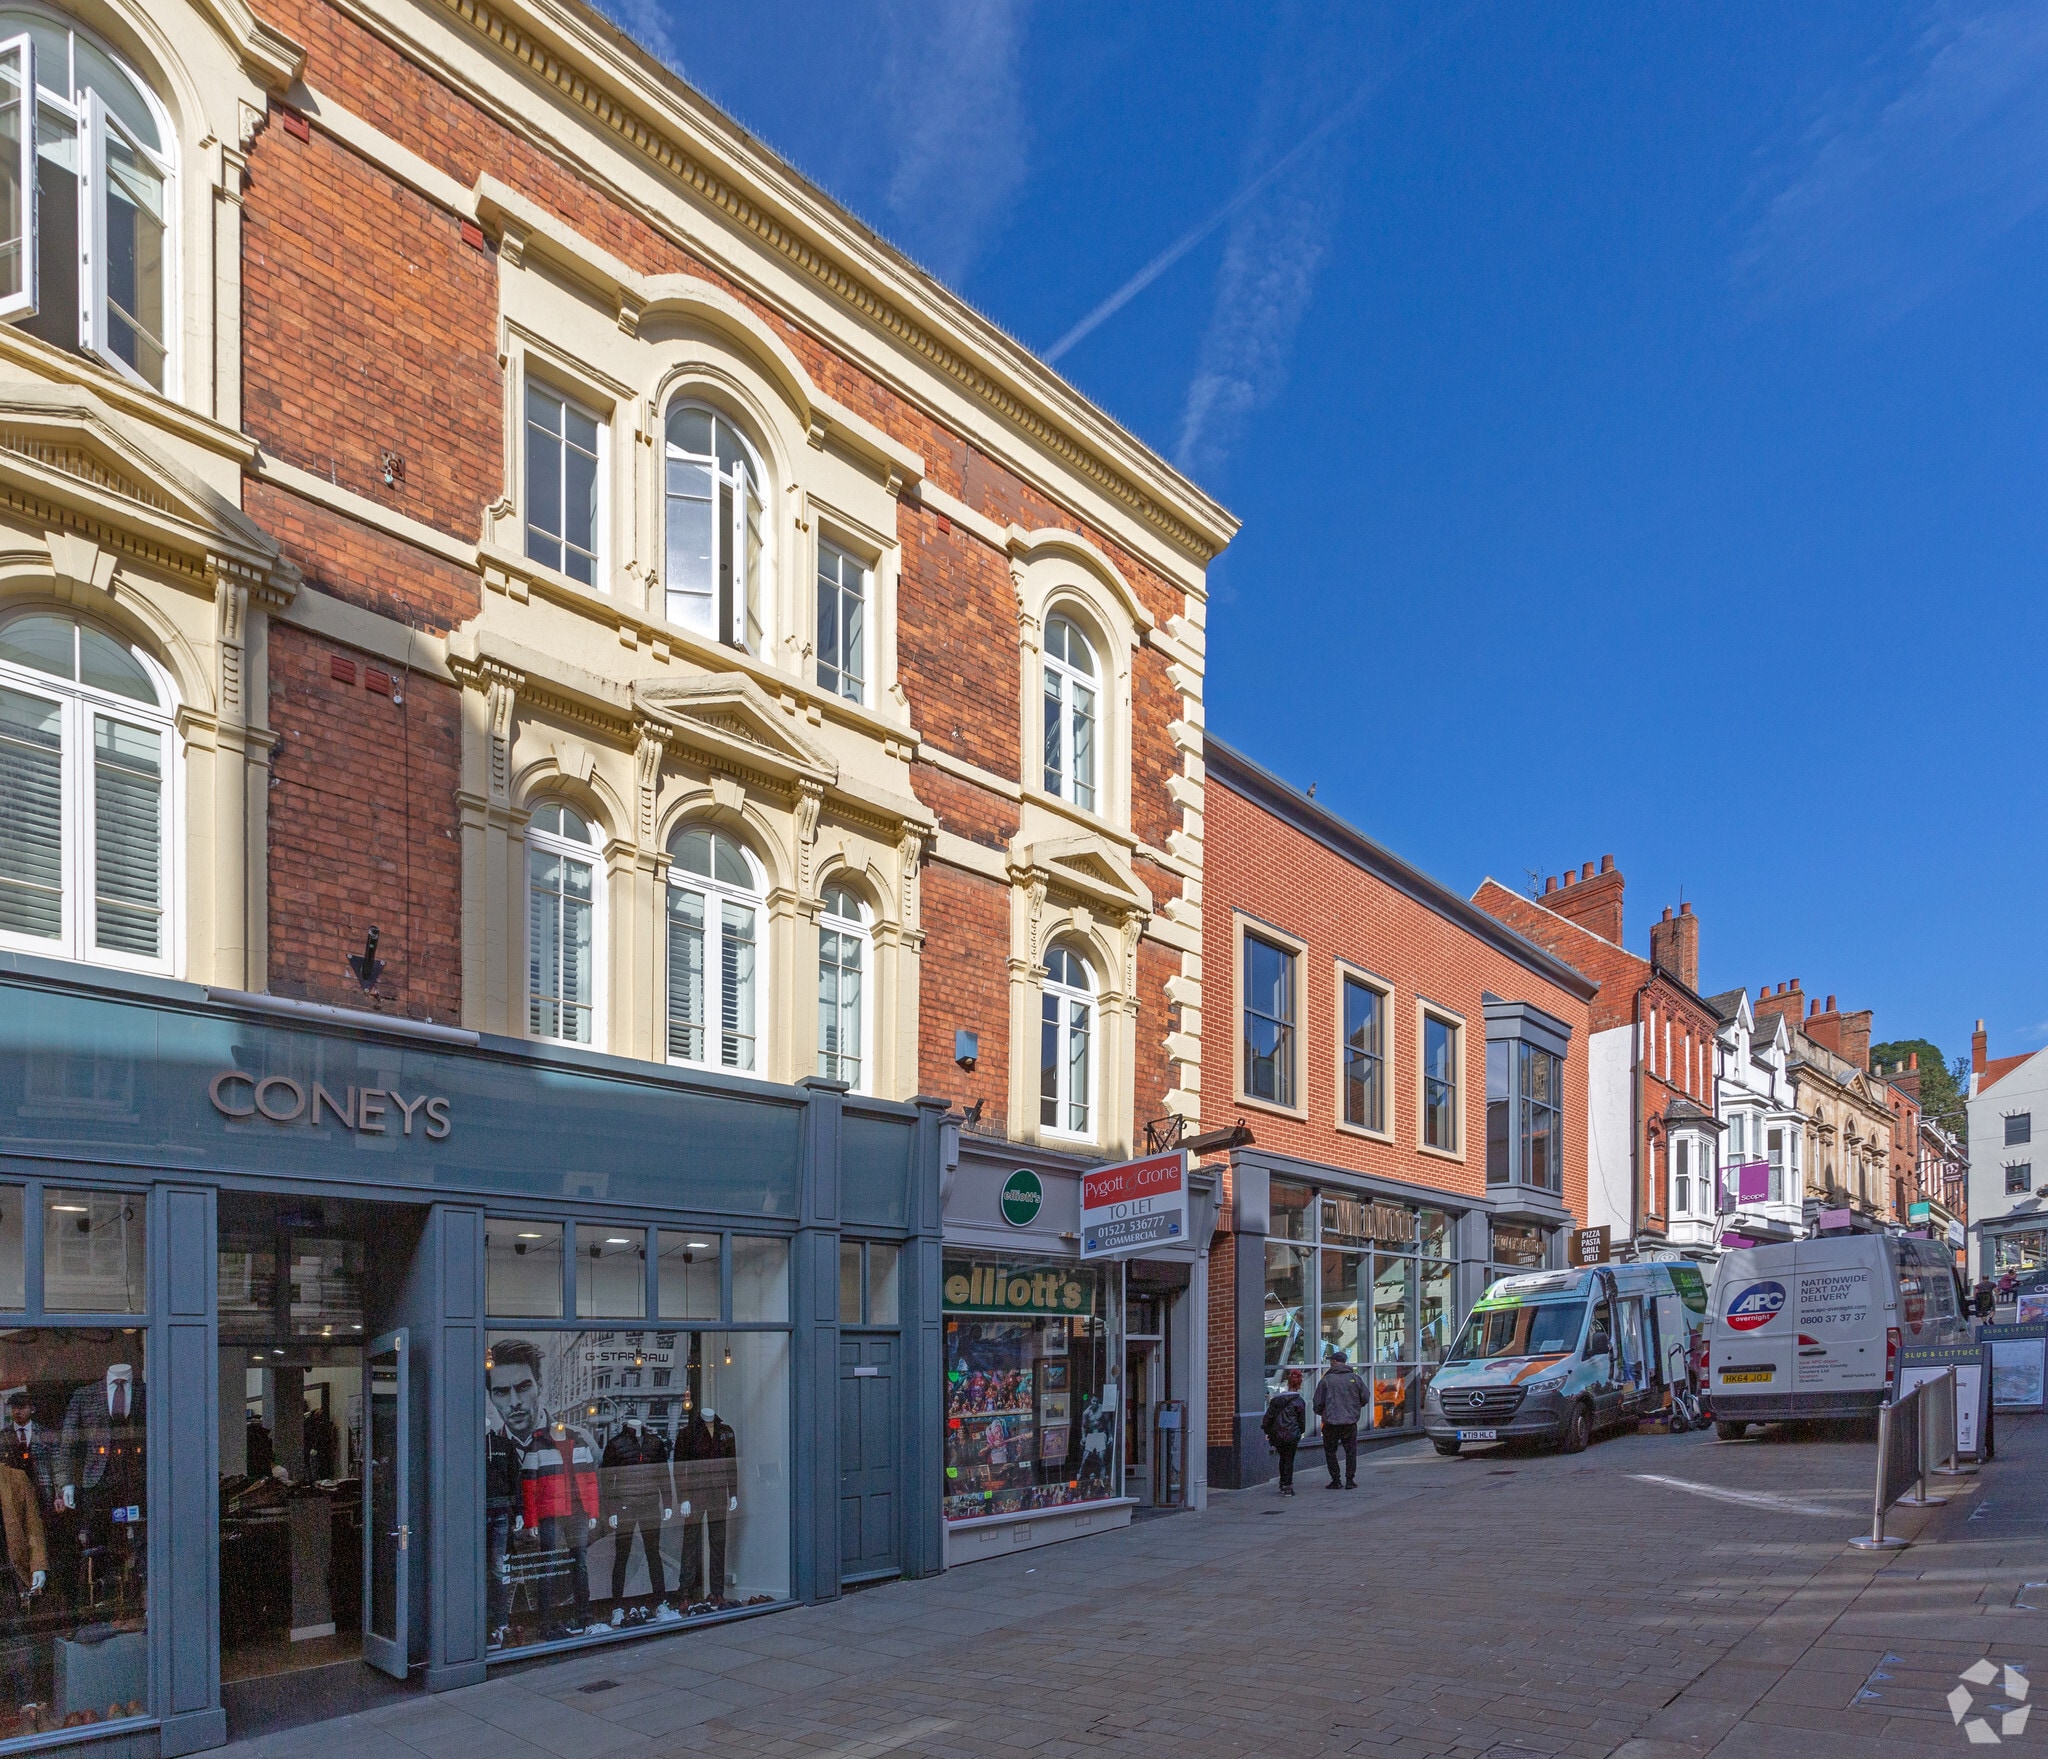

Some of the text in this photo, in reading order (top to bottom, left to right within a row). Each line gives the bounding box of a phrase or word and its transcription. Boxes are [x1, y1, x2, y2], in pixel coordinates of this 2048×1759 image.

[208, 1070, 451, 1139] CONEYS
[1085, 1176, 1123, 1197] Pygott
[1137, 1166, 1178, 1184] Crone
[1004, 1190, 1041, 1203] elliott's
[1741, 1192, 1765, 1201] Scope
[1108, 1197, 1154, 1220] TO LET
[1098, 1223, 1126, 1238] 01522
[1129, 1215, 1165, 1232] 536777
[1335, 1199, 1415, 1243] WILDWOOD
[1105, 1230, 1157, 1246] COMMERCIAL
[1581, 1229, 1601, 1239] PIZZA
[1581, 1237, 1601, 1247] PASTA
[1581, 1246, 1601, 1255] GRILL
[1583, 1255, 1598, 1263] DELI
[1801, 1275, 1867, 1287] NATIONWIDE
[945, 1267, 1081, 1309] elliott's
[1801, 1284, 1852, 1295] NEXT DAY
[1735, 1292, 1783, 1312] APC
[1801, 1292, 1849, 1303] DELIVERY
[1735, 1314, 1770, 1322] overnight
[1800, 1313, 1866, 1325] 0800 37 37 37
[585, 1352, 669, 1362] G-STAR RAW
[1726, 1372, 1768, 1383] HK64 JOJ
